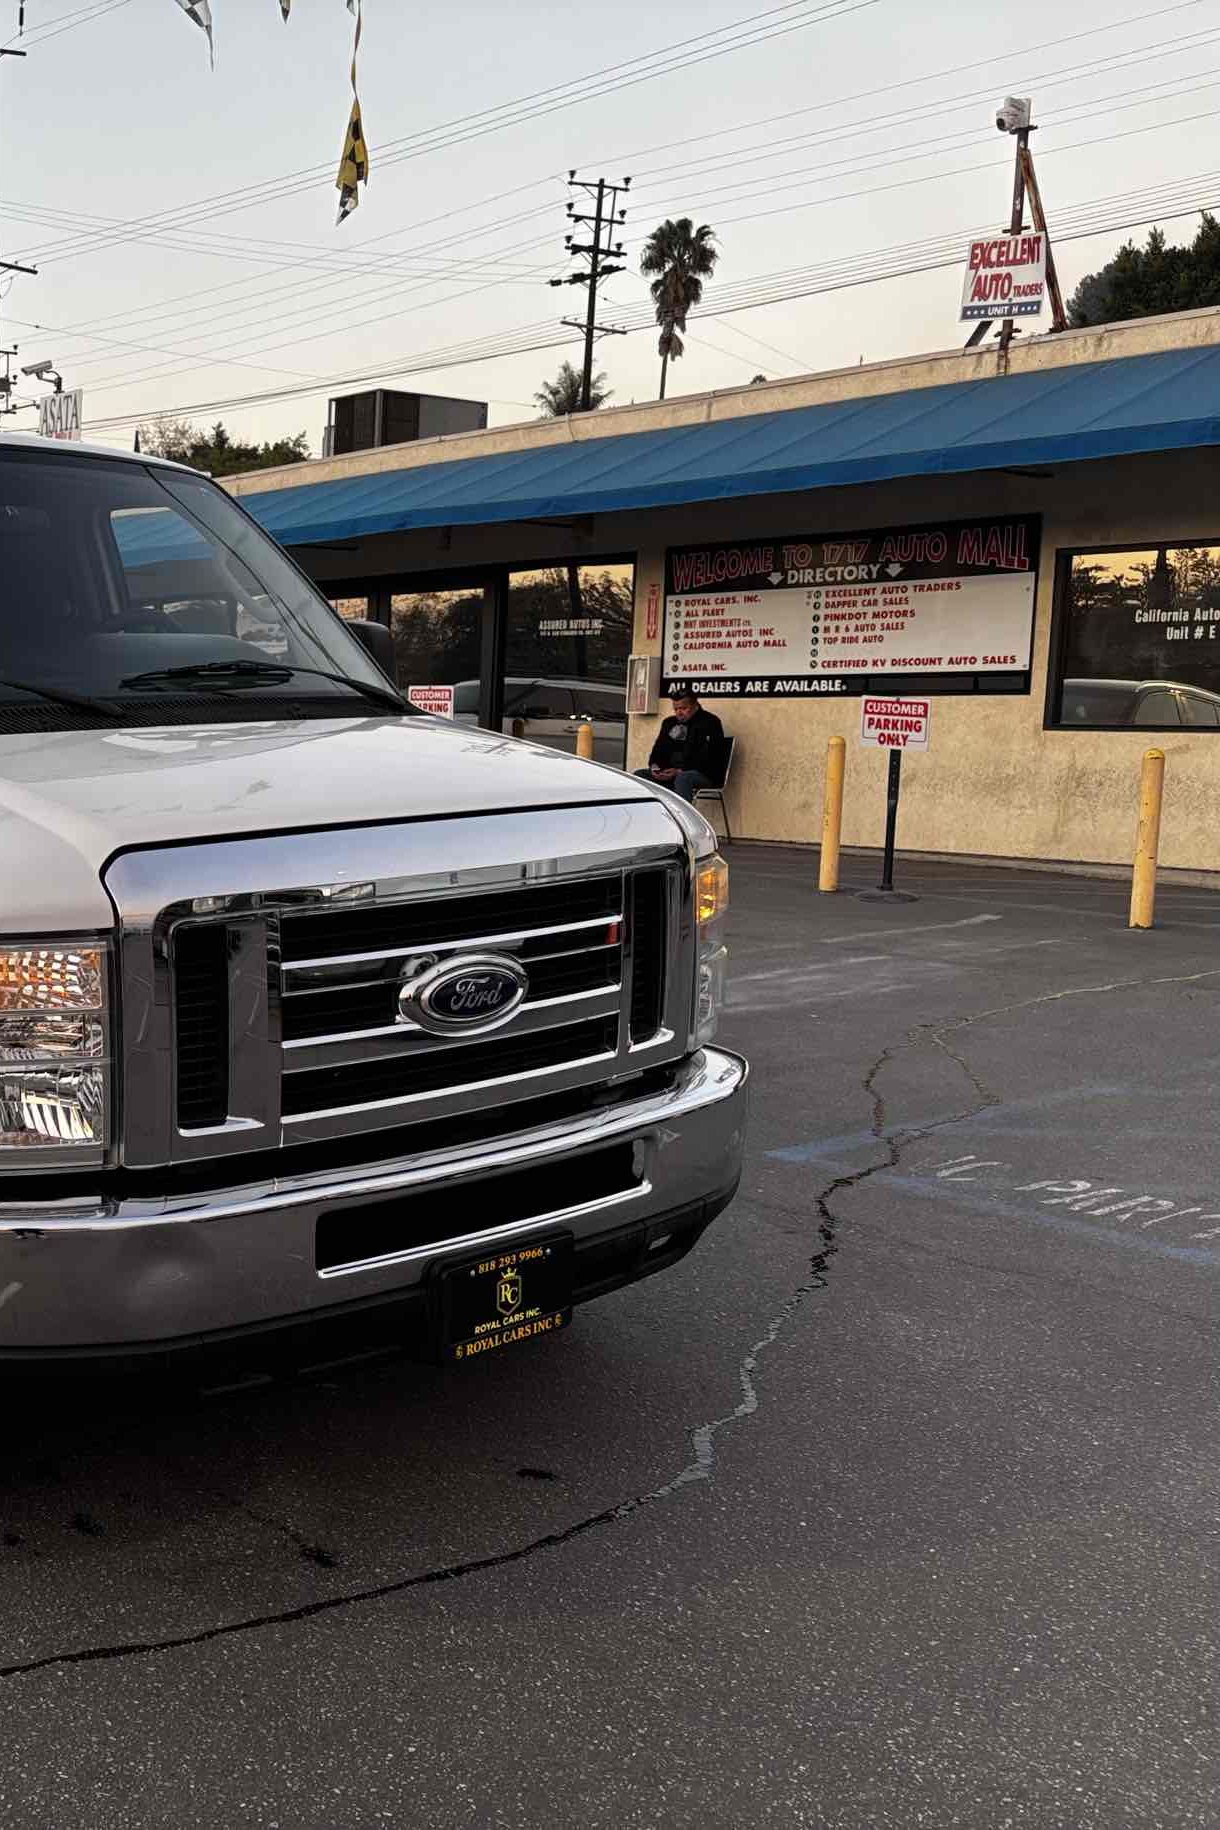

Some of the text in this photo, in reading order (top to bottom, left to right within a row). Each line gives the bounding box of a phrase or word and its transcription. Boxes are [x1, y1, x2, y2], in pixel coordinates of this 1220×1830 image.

[969, 235, 1042, 270] EXCELLENT
[970, 271, 1043, 303] AUTO TRADERS
[987, 305, 1008, 316] UNIT
[40, 393, 79, 436] ASATA
[672, 524, 1029, 594] WELCOME TO 1717 AUTO MALL
[787, 564, 881, 584] DIRECTORY
[825, 582, 962, 599] EXCELLENT AUTO TRADERS
[684, 597, 711, 607] ROYAL
[824, 596, 909, 609] DAPPER CAR SALES
[685, 608, 725, 618] ALL FLEET
[824, 609, 916, 621] PINKDOT MOTORS
[1135, 609, 1189, 623] California
[854, 623, 876, 632] AUTO
[880, 621, 905, 631] SALES
[1166, 626, 1189, 640] Unit
[1194, 626, 1204, 639] #
[684, 629, 722, 639] ASSURED
[822, 637, 838, 645] TOP
[862, 635, 884, 643] AUTO
[684, 639, 787, 650] CALIFORNIA AUTO MALL
[682, 664, 707, 672] ASATA
[821, 655, 1017, 669] CERTIFIED KV DISCOUNT AUTO SALES
[692, 681, 740, 693] DEALERS
[745, 681, 769, 692] ARE
[774, 679, 848, 691] AVAILABLE.
[411, 690, 451, 699] CUSTOMER
[866, 702, 925, 716] CUSTOMER
[867, 717, 922, 733] PARKING
[877, 733, 909, 746] ONLY
[451, 976, 503, 1011] Ford
[478, 1260, 496, 1274] 818
[499, 1254, 517, 1269] 293
[474, 1320, 502, 1335] ROYAL
[502, 1312, 525, 1326] CARS
[465, 1317, 553, 1356] ROYAL CARS INC
